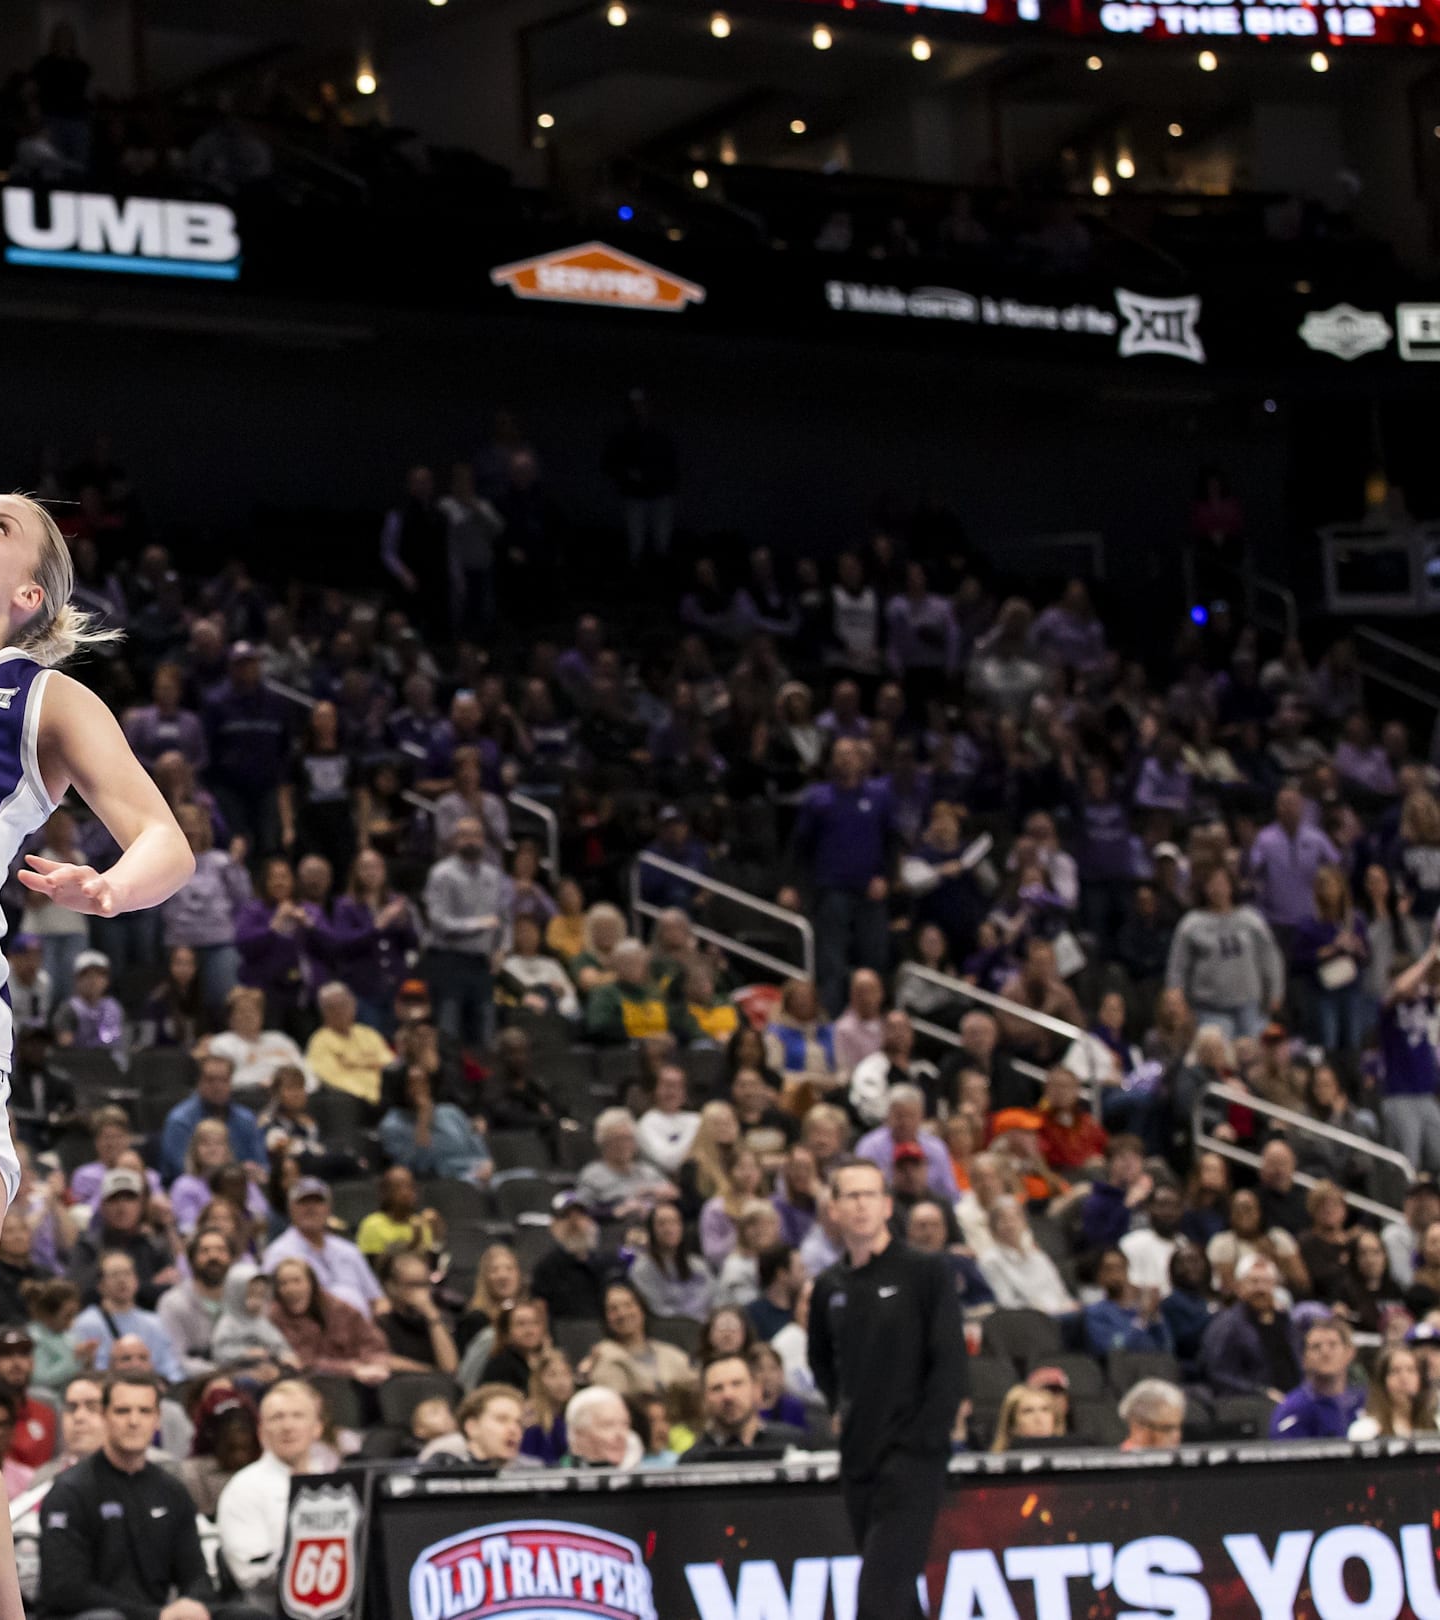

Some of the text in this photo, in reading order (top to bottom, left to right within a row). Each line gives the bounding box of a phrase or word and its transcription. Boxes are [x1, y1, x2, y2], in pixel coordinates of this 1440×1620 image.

[1100, 6, 1376, 36] OF THE BIG 12
[1, 185, 241, 263] UMB
[294, 1542, 345, 1597] 66
[480, 1535, 657, 1620] TRAPPER
